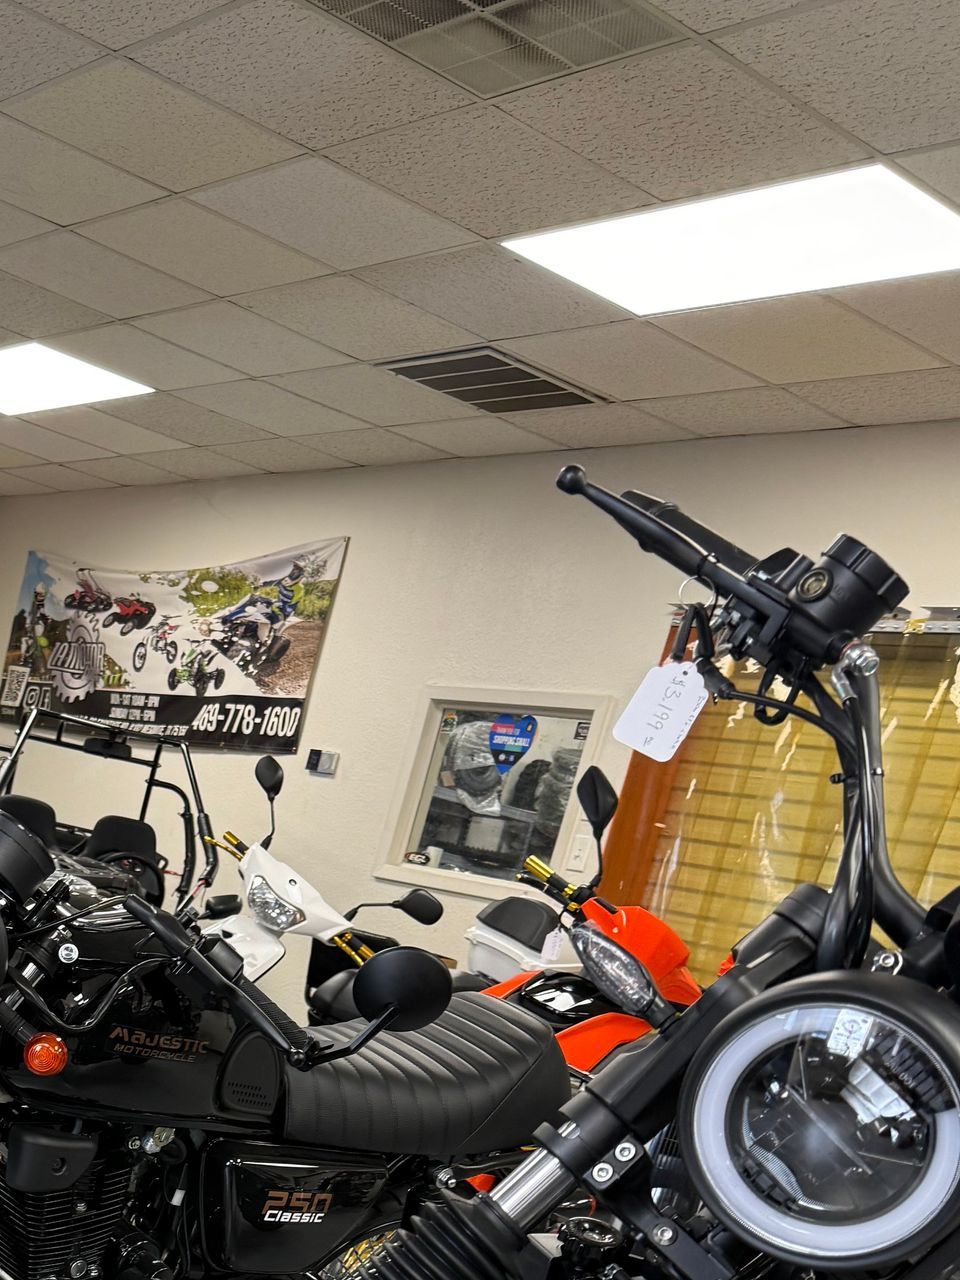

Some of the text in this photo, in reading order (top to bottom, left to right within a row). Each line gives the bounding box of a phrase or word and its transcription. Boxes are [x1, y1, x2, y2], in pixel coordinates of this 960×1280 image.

[191, 703, 301, 737] 469-778-1600
[113, 1043, 197, 1063] MOTORCYCLE
[262, 1190, 333, 1215] 250
[263, 1209, 325, 1223] Classic
